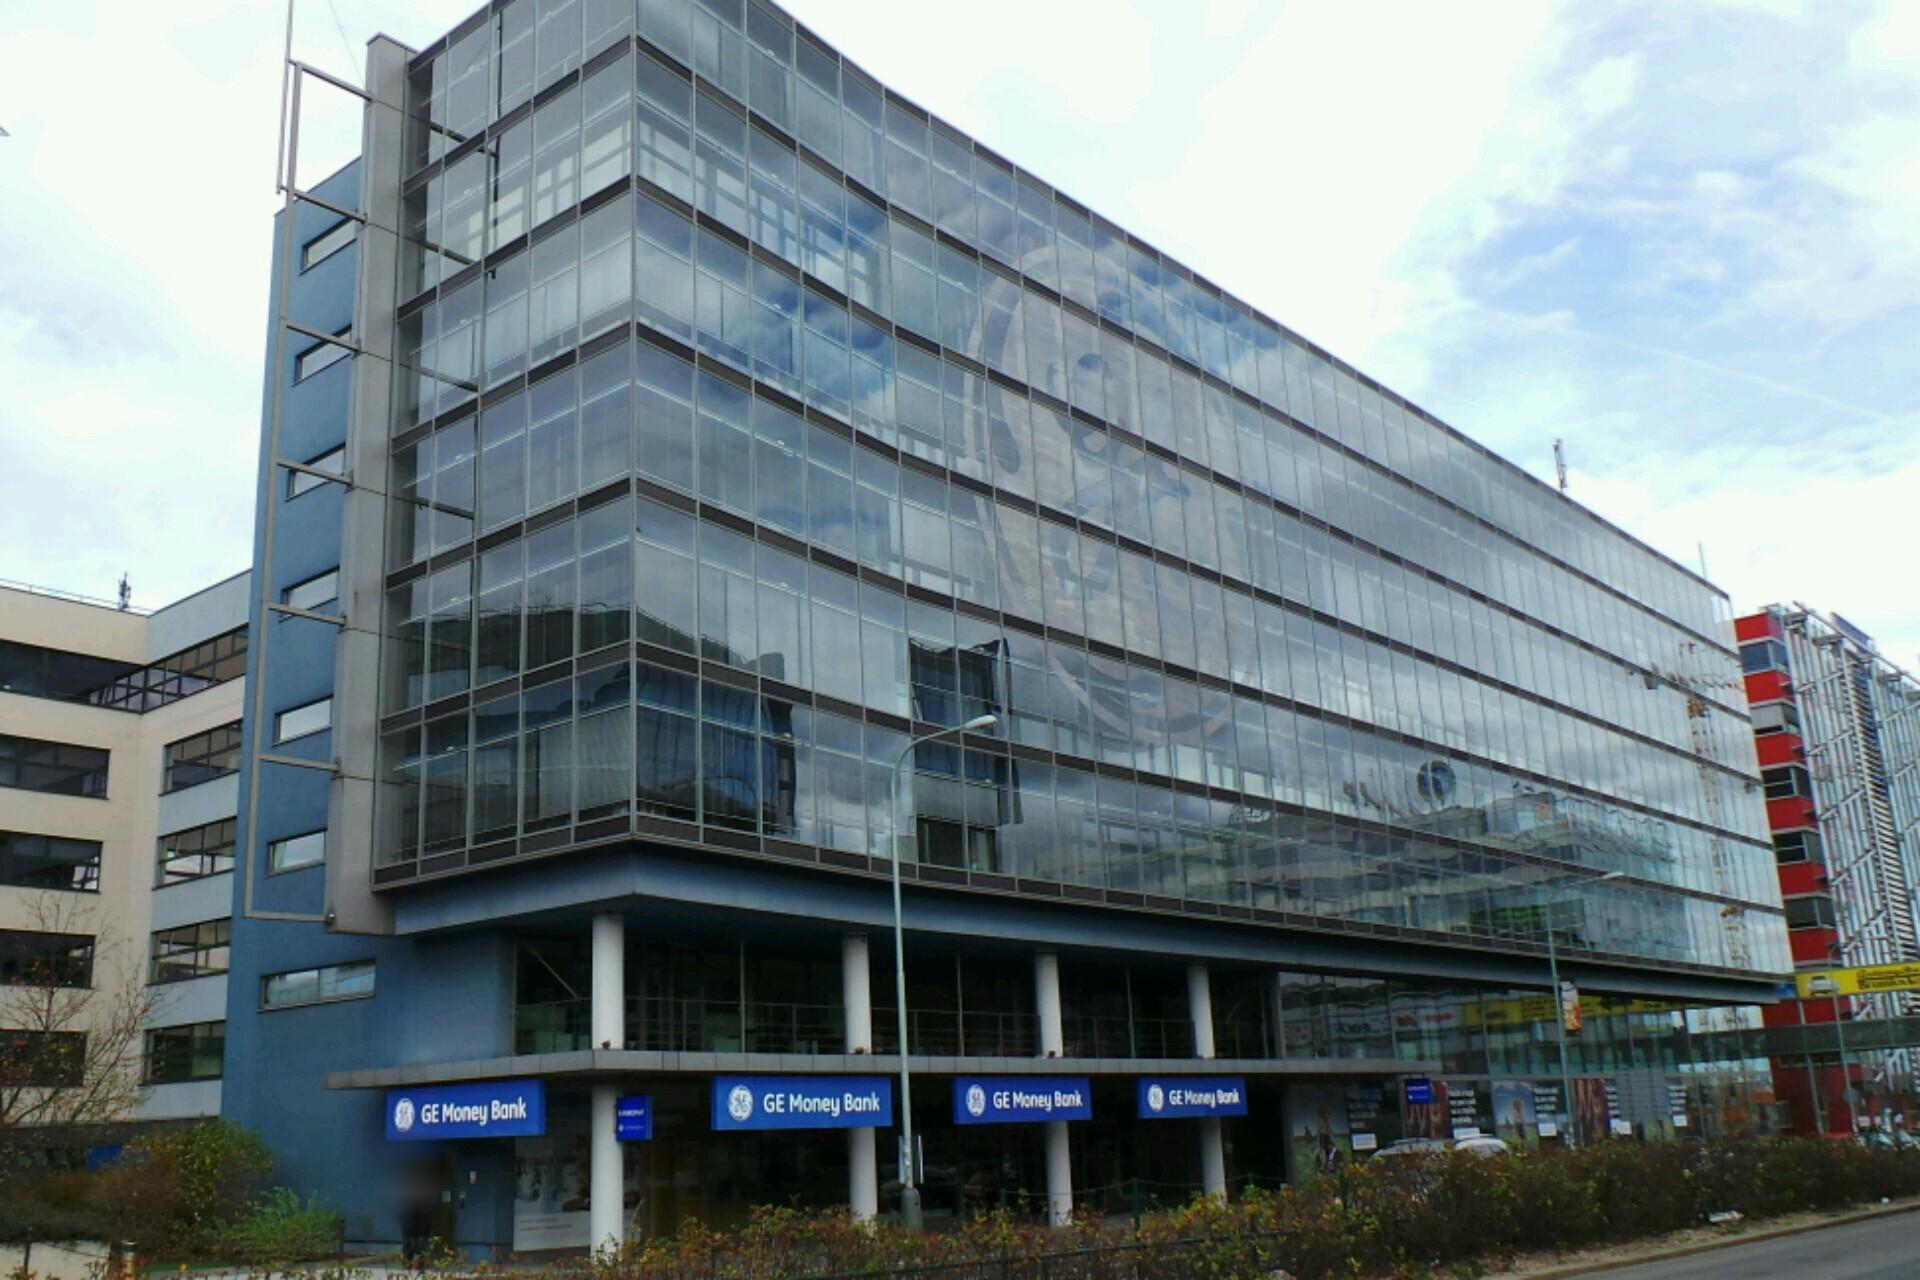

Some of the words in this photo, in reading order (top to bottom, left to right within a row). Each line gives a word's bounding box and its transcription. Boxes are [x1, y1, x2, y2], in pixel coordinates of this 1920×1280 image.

[763, 1093, 785, 1113] GE
[789, 1092, 840, 1117] Money
[844, 1091, 881, 1112] Bank
[993, 1091, 1010, 1109] GE
[1013, 1091, 1051, 1112] Money
[1054, 1089, 1083, 1107] Bank
[1169, 1090, 1183, 1105] GE
[1184, 1089, 1215, 1109] Money
[1216, 1088, 1240, 1104] Bank
[421, 1103, 439, 1124] GE
[442, 1102, 488, 1126] Money
[491, 1096, 526, 1120] Bank
